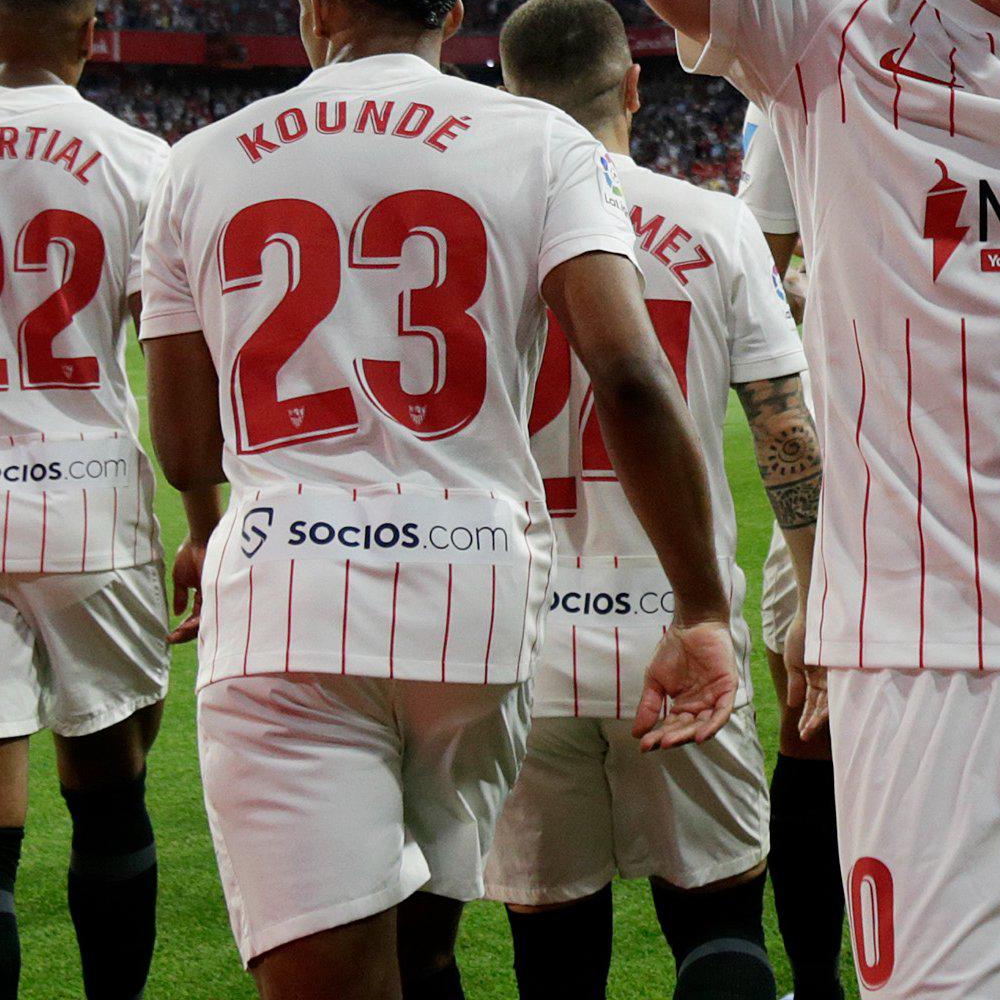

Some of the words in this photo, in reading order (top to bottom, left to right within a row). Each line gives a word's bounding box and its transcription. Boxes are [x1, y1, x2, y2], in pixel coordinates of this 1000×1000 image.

[236, 100, 472, 163] KOUNDÉ
[220, 190, 488, 455] 23
[0, 459, 127, 482] CIOS.com
[288, 520, 508, 552] SOCIOS.com
